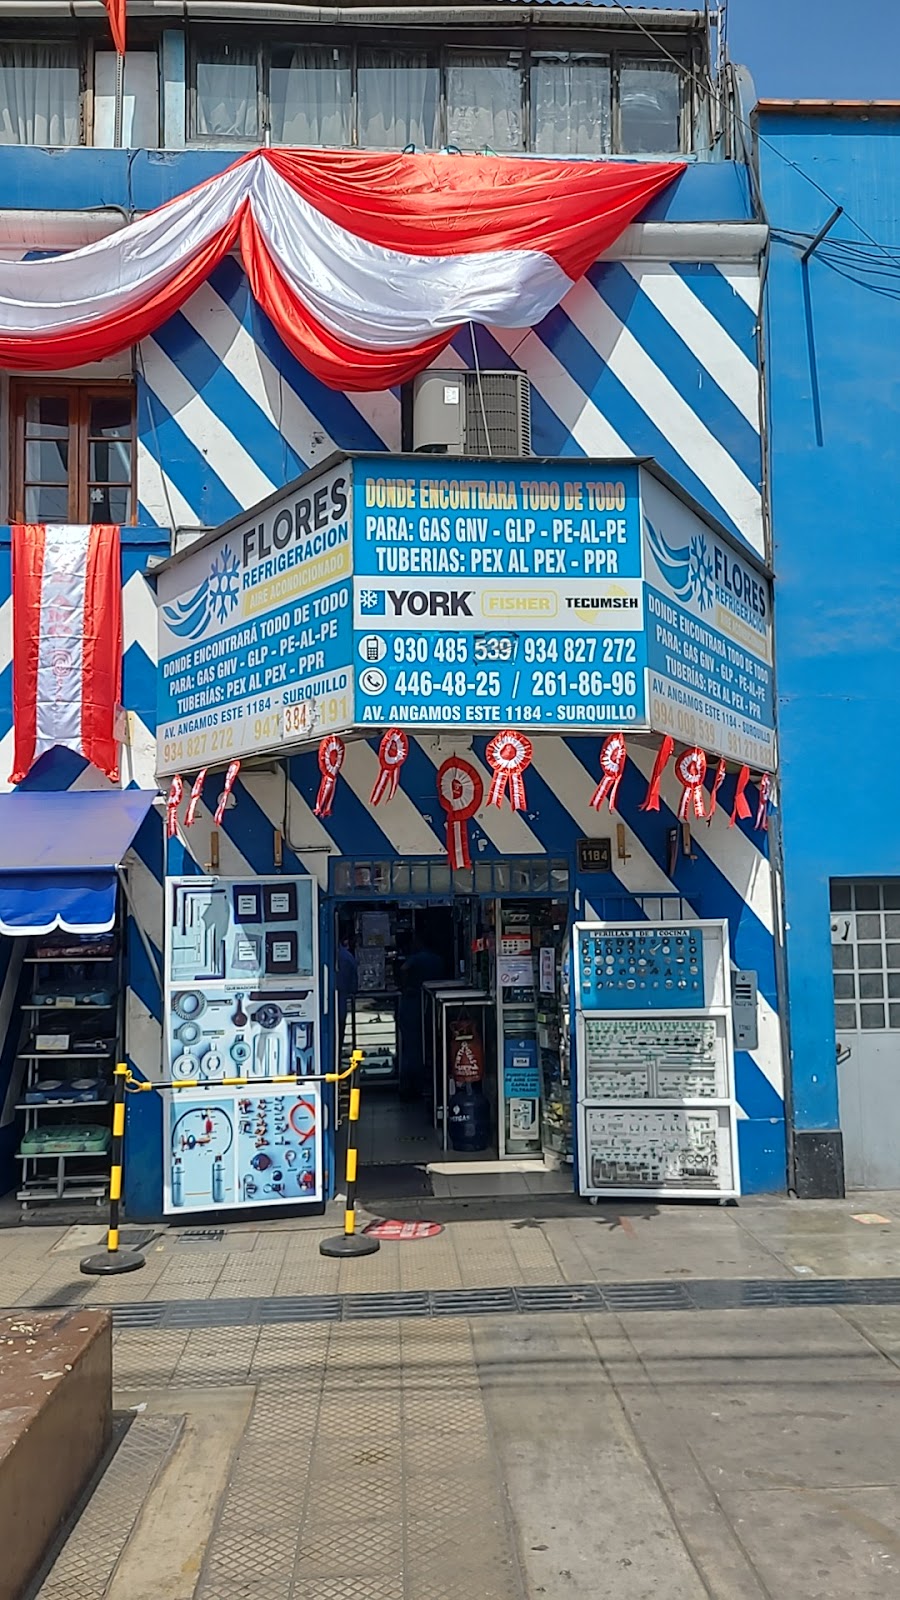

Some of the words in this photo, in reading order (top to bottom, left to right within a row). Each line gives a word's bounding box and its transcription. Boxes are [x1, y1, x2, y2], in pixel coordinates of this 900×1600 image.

[243, 477, 347, 568] FLORES
[366, 478, 415, 509] DONDE
[420, 479, 517, 510] ENCONTRARA
[520, 481, 560, 511] TODO
[564, 482, 583, 511] DE
[586, 482, 626, 512] TODO
[243, 521, 348, 590] REFRIGERACION
[366, 516, 414, 542] PARA:
[419, 517, 450, 543] GAS
[455, 518, 488, 543] GNV
[505, 519, 536, 543] GLP
[553, 519, 627, 544] PE-AL-PE
[250, 589, 268, 609] AIRE
[270, 553, 344, 600] ACONDICIONADO
[376, 547, 465, 573] TUBERIAS:
[471, 549, 503, 573] PEX
[508, 549, 529, 573] AL
[534, 550, 566, 573] PEX
[584, 550, 618, 574] PPR
[714, 545, 766, 617] FLORES
[387, 590, 474, 617] YORK
[489, 597, 550, 611] FISHER
[565, 597, 638, 609] TECUMSEH
[163, 655, 192, 679] DONDE
[194, 622, 258, 668] ENCONTRARÁ
[260, 614, 290, 640] TODO
[294, 603, 310, 627] DE
[313, 588, 349, 618] TODO
[169, 675, 195, 697] PARA:
[197, 668, 215, 687] GAS
[217, 657, 237, 679] GNV
[248, 645, 269, 668] GLP
[280, 619, 338, 657] PE-AL-PE
[394, 638, 428, 663] 930
[434, 638, 467, 663] 485
[474, 638, 512, 661] 539
[524, 638, 558, 663] 934
[564, 638, 597, 663] 827
[603, 638, 637, 663] 272
[648, 593, 678, 628] DONDE
[679, 614, 727, 657] ENCONTRARÁ
[727, 645, 745, 669] TODO
[745, 656, 753, 674] DE
[754, 661, 769, 685] TODO
[656, 624, 682, 652] PARA:
[683, 641, 699, 664] GAS
[700, 653, 715, 674] GNV
[720, 663, 734, 685] GLP
[738, 674, 766, 702] PE-AL-PE
[164, 726, 176, 740] AV.
[177, 713, 218, 738] ANGAMOS
[221, 705, 243, 723] ESTE
[246, 697, 271, 717] 1184
[282, 674, 347, 706] SURQUILLO
[177, 686, 225, 715] TUBERÍAS:
[226, 677, 246, 699] PEX
[248, 672, 262, 692] AL
[264, 664, 287, 686] PEX
[299, 650, 325, 675] PPR
[394, 671, 500, 697] 446-48-25
[511, 671, 520, 699] /
[531, 671, 636, 697] 261-86-96
[652, 678, 665, 695] AV.
[667, 685, 703, 714] ANGAMOS
[704, 702, 721, 722] ESTE
[722, 709, 737, 728] 1184
[742, 721, 771, 744] SURQUILLO
[653, 698, 674, 726] 994
[665, 655, 707, 693] TUBERÍAS:
[707, 680, 722, 700] PEX
[722, 687, 731, 705] AL
[731, 692, 744, 712] PEX
[749, 701, 761, 720] PPR
[164, 744, 183, 763] 934
[187, 736, 207, 758] 827
[211, 726, 233, 752] 272
[254, 713, 280, 741] 947
[285, 704, 306, 732] 384
[320, 696, 348, 724] 191
[363, 706, 385, 721] AV.
[389, 706, 461, 721] ANGAMOS
[465, 706, 500, 721] ESTE
[506, 706, 541, 721] 1184
[557, 706, 636, 722] SURQUILLO
[582, 850, 608, 861] 1184
